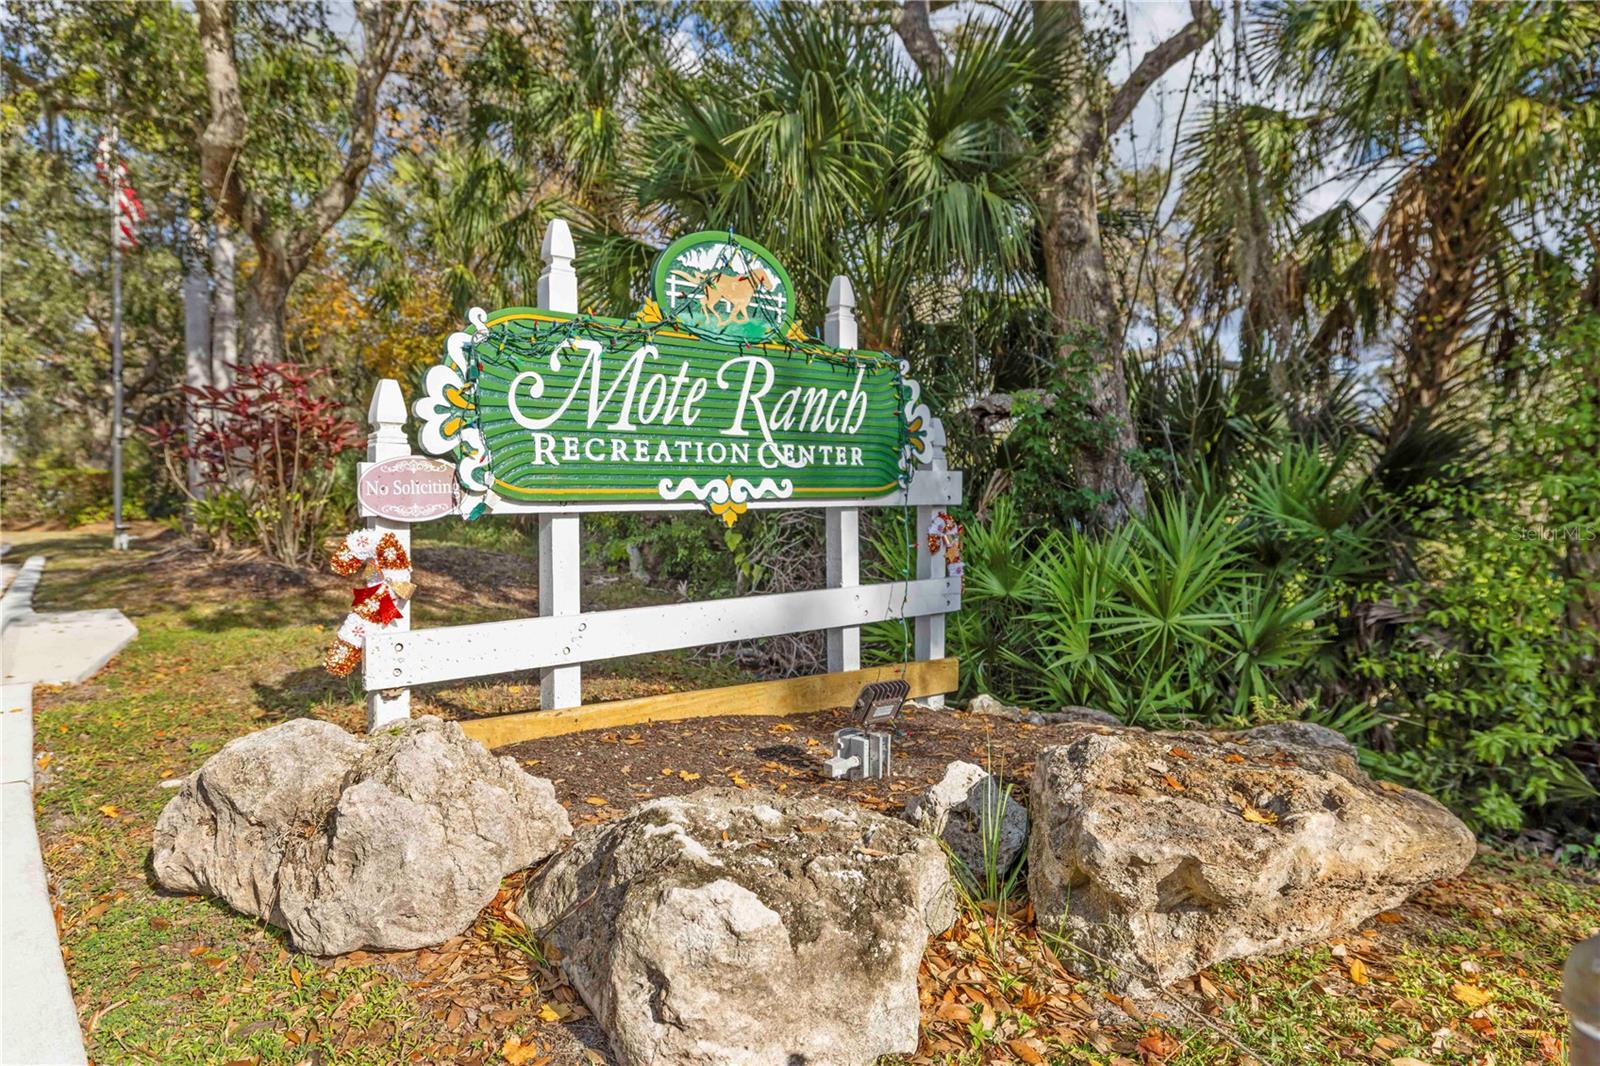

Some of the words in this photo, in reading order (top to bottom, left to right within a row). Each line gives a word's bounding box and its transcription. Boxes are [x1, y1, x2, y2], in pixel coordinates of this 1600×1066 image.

[507, 338, 707, 431] Mote
[716, 355, 868, 468] Ranch
[531, 433, 749, 466] RECREATION
[757, 442, 864, 469] CENTER
[366, 481, 389, 496] No
